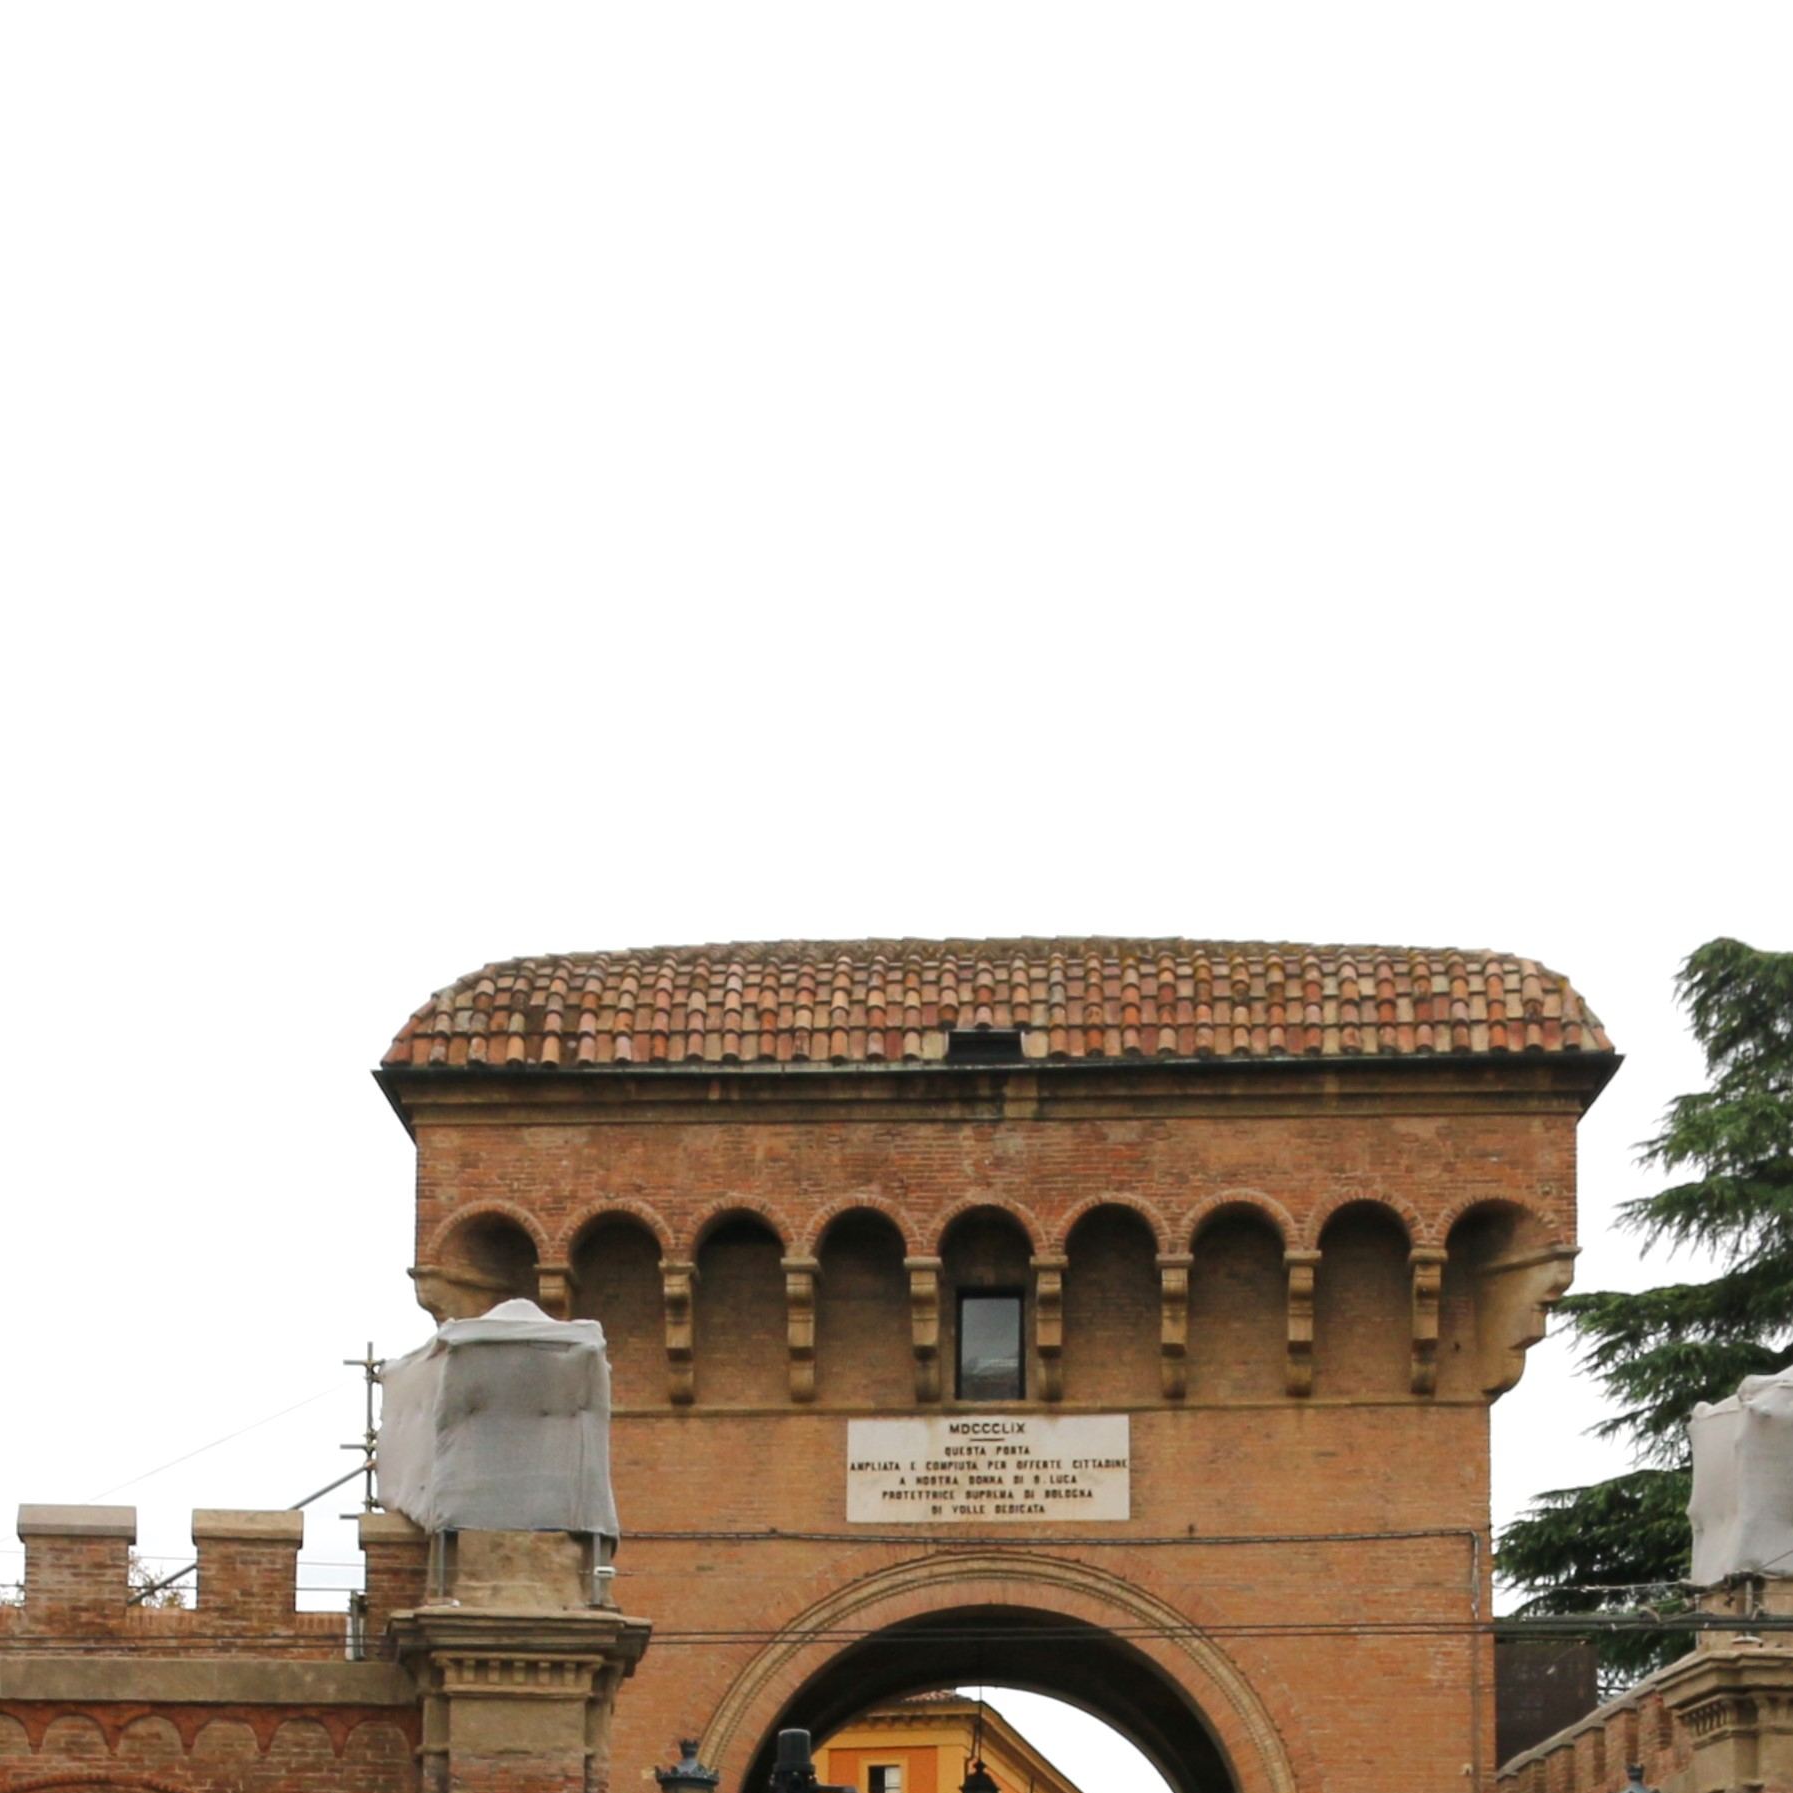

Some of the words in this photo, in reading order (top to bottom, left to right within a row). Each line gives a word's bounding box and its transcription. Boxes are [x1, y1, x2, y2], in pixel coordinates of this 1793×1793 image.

[945, 1446, 986, 1456] QUESTA
[996, 1446, 1030, 1455] PORTA
[850, 1461, 900, 1471] AMPLIATA
[910, 1461, 916, 1470] E
[926, 1461, 978, 1471] COMPIUTA
[987, 1460, 1007, 1470] PER
[1016, 1460, 1062, 1469] OFFERTE
[1072, 1459, 1127, 1468] CITTADINE
[900, 1476, 906, 1485] A
[916, 1476, 959, 1485] NOSTRA
[1013, 1475, 1024, 1484] DI
[1050, 1475, 1077, 1483] LUCA
[882, 1491, 955, 1500] PROTETTRICE
[965, 1490, 1014, 1499] SUPREMA
[1024, 1490, 1034, 1499] DI
[1045, 1489, 1093, 1498] BOLOGNA
[952, 1505, 985, 1514] VOLLE
[995, 1504, 1045, 1514] DEDICATA
